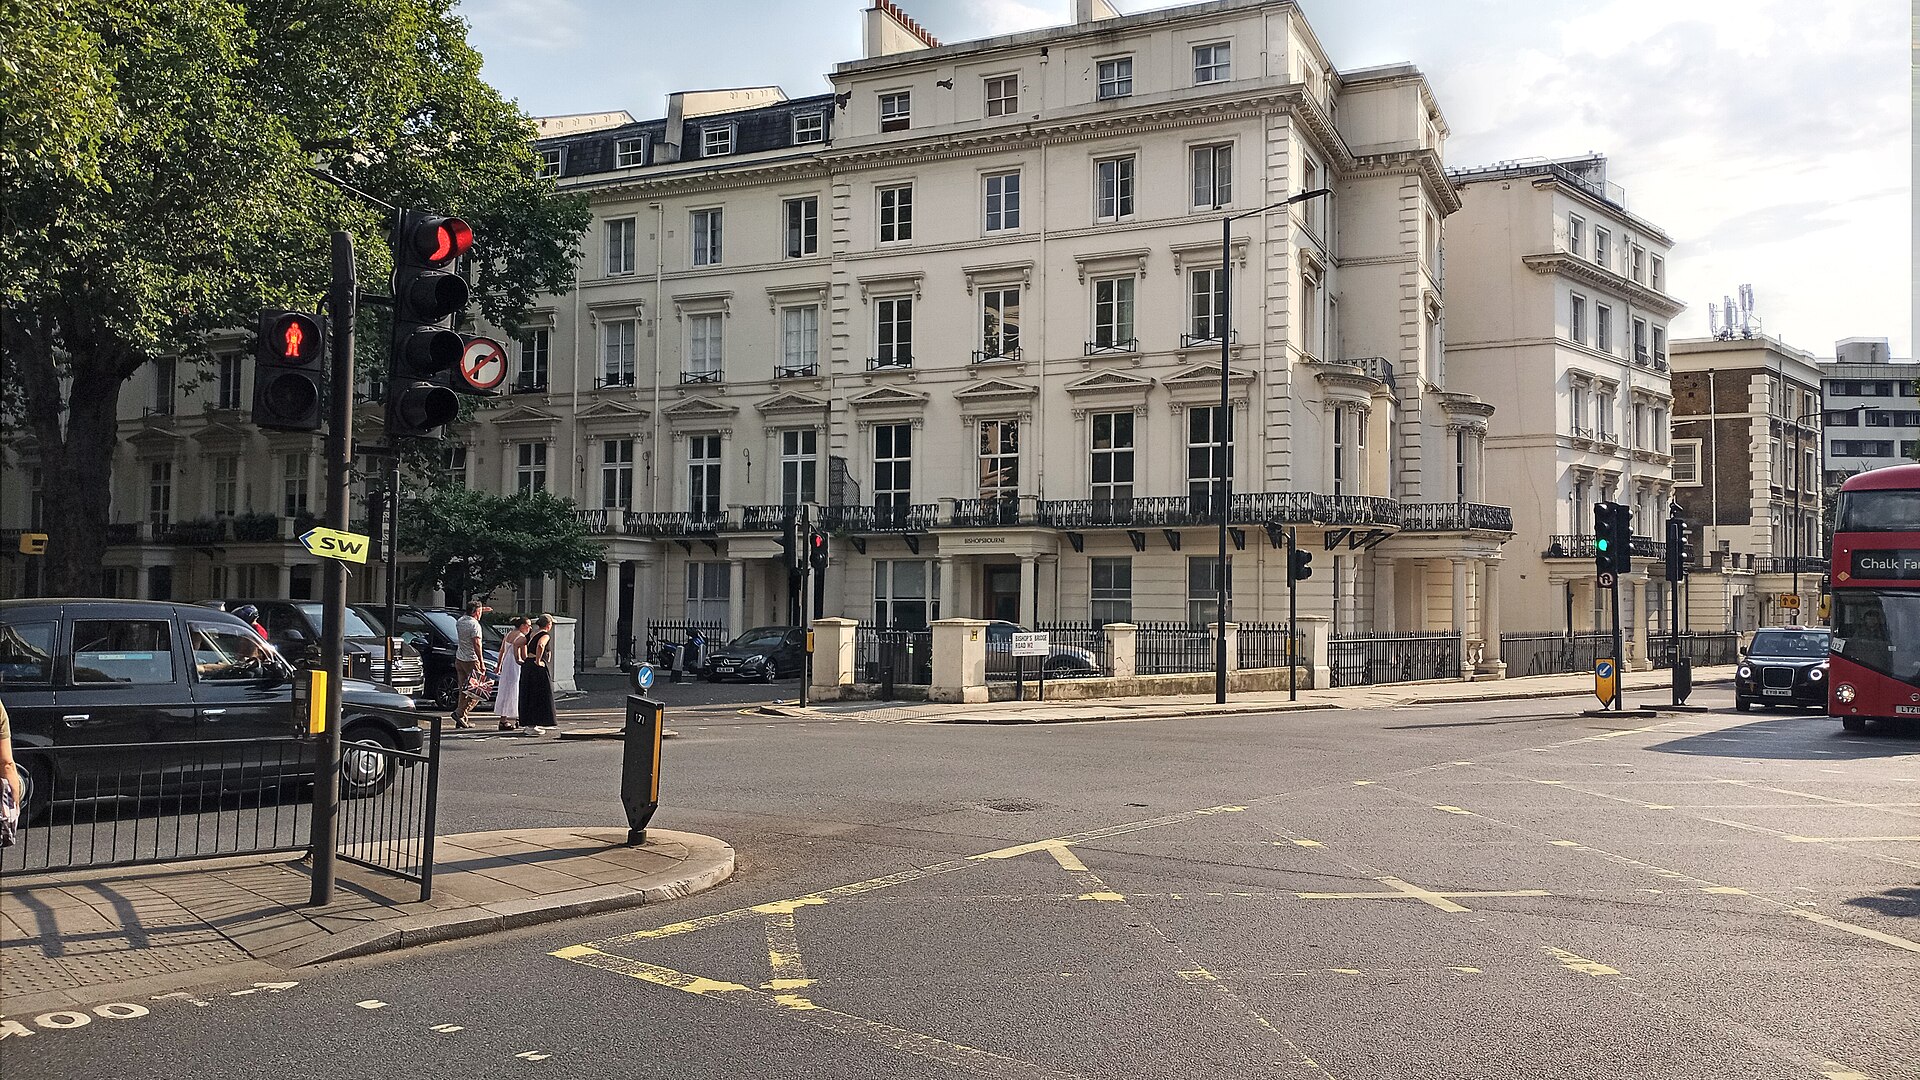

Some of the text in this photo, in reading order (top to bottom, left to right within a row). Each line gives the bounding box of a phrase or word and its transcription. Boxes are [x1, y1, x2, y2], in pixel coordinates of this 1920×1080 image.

[320, 537, 363, 554] SW
[1860, 558, 1899, 569] Chalk
[1034, 634, 1047, 642] BRIDGE
